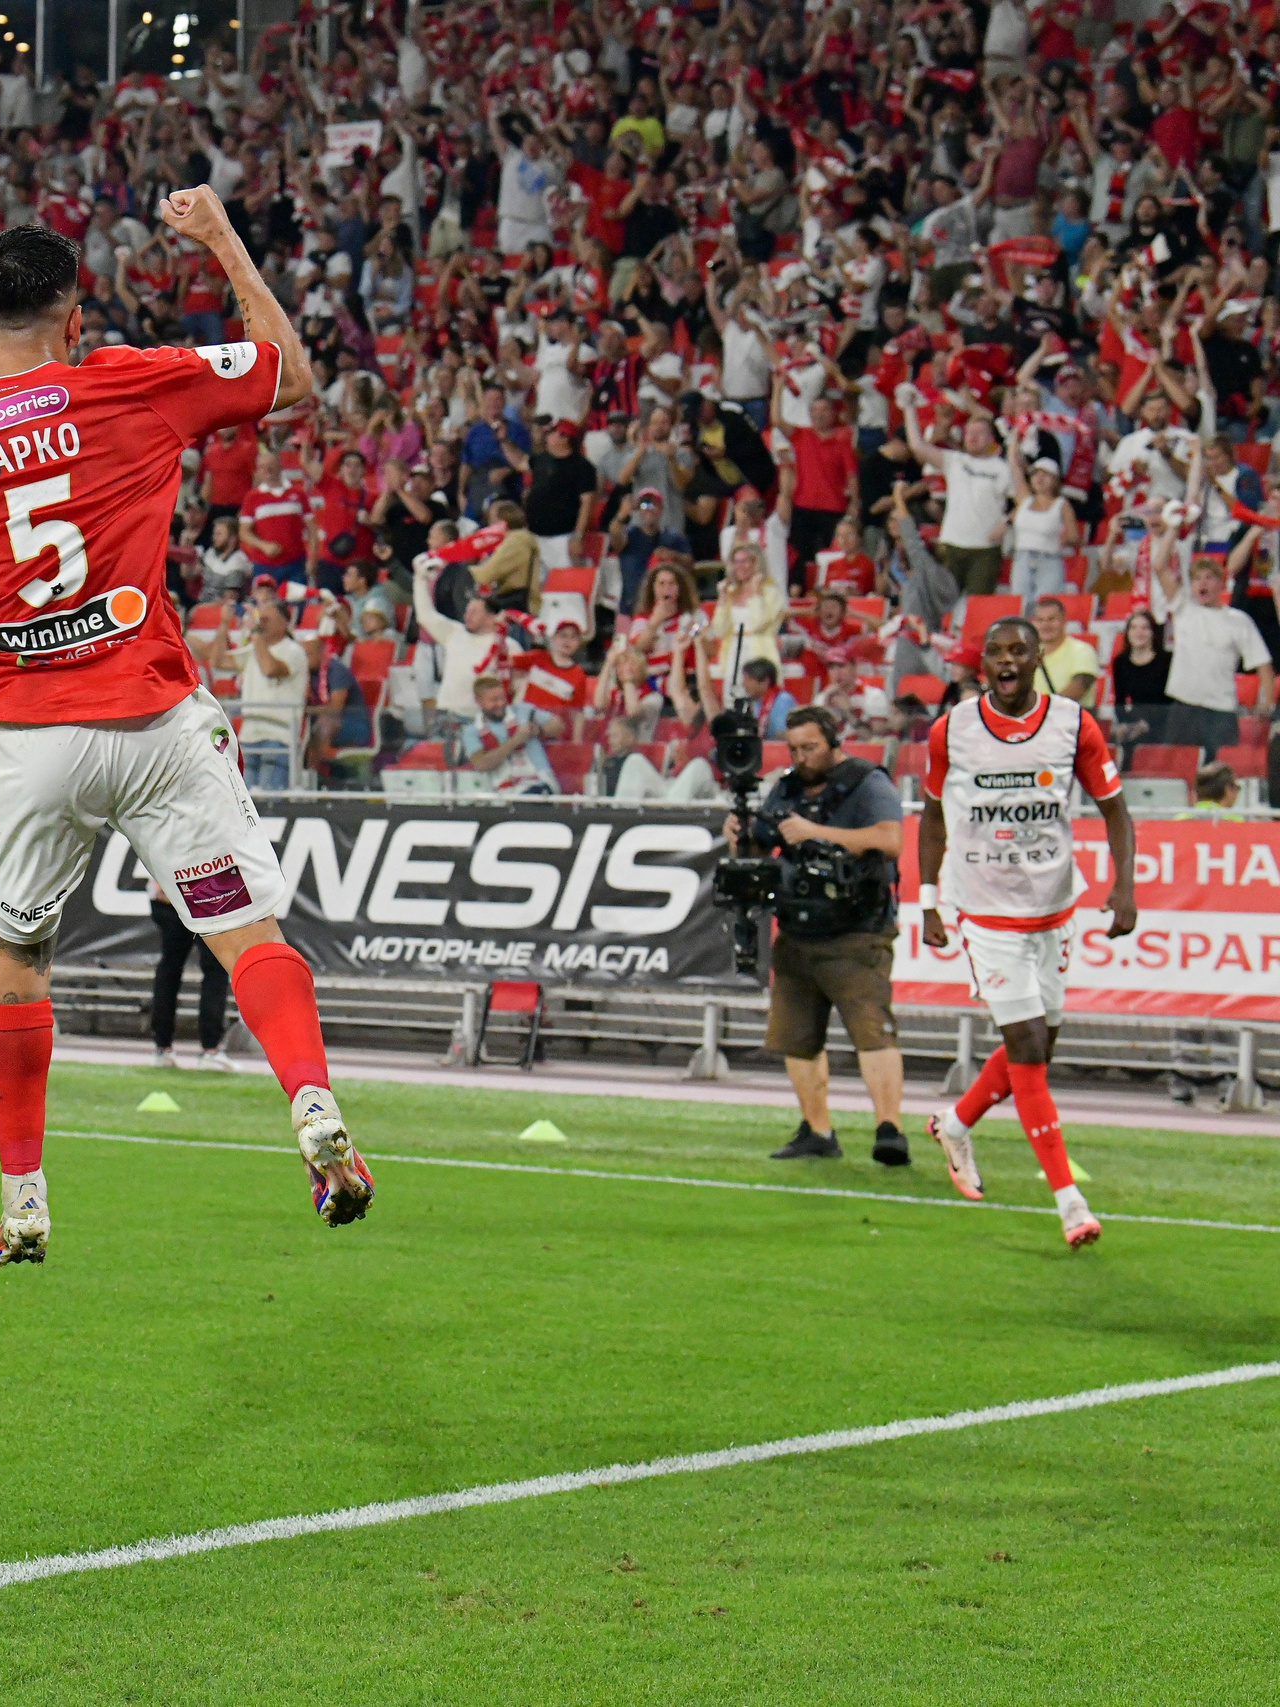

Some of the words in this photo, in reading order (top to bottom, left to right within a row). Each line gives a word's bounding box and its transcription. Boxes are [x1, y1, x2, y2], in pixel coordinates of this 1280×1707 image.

[4, 472, 89, 609] 5
[969, 801, 1060, 823] ЛУКОЙЛ
[173, 853, 235, 881] ЛУКОЙЛ
[965, 846, 1059, 864] CHERY
[91, 816, 714, 935] GNESIS
[349, 935, 536, 967] МОТОРНЫЕ
[542, 943, 670, 973] МАСЛА
